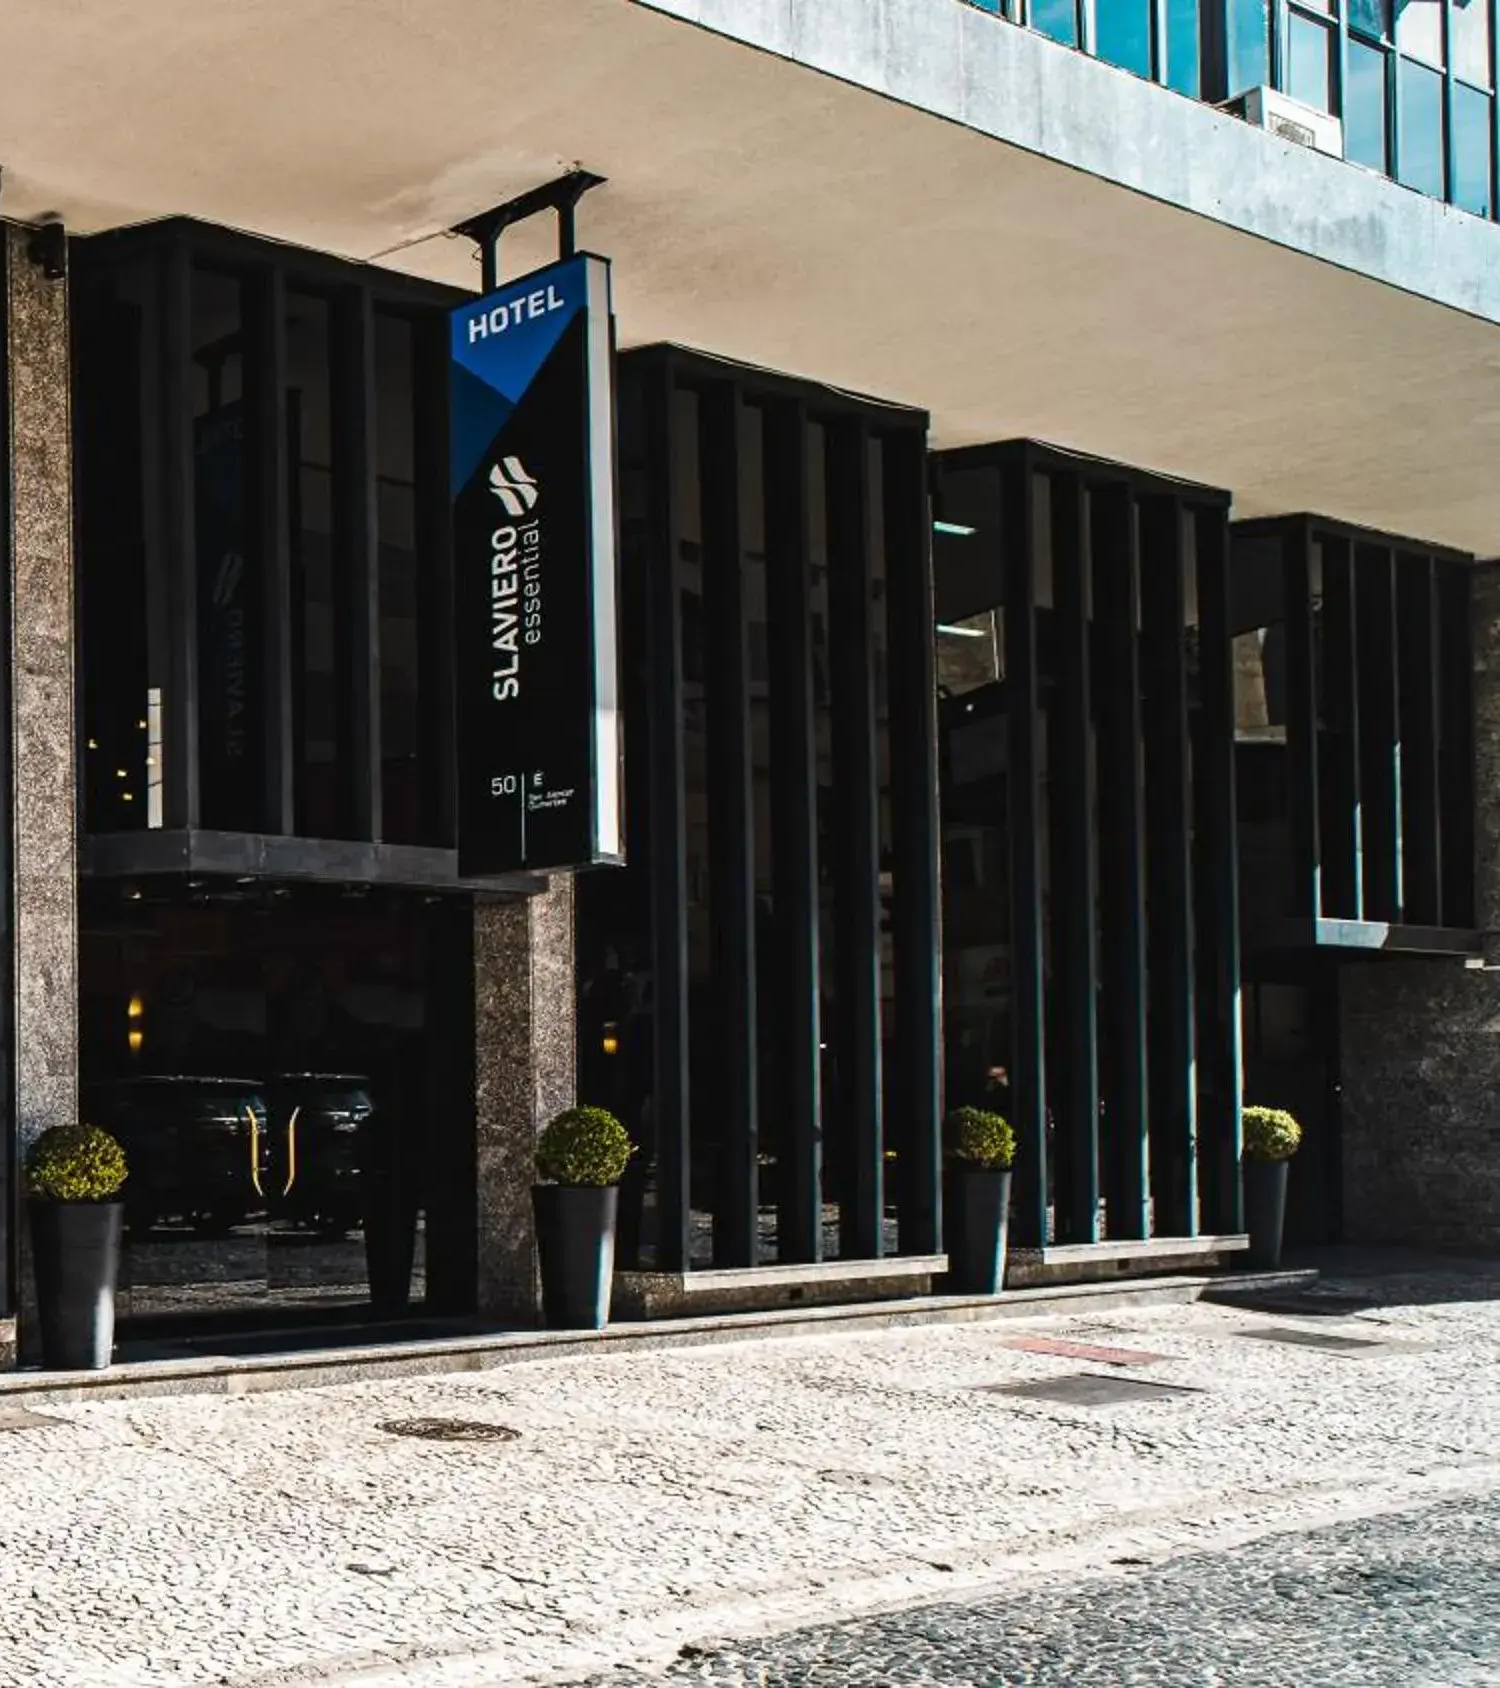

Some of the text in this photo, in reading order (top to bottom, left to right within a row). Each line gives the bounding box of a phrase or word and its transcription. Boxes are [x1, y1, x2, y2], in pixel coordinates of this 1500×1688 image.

[468, 284, 565, 344] HOTEL
[491, 525, 520, 702] SLAVIERO
[518, 518, 542, 645] essential
[491, 774, 517, 796] 50
